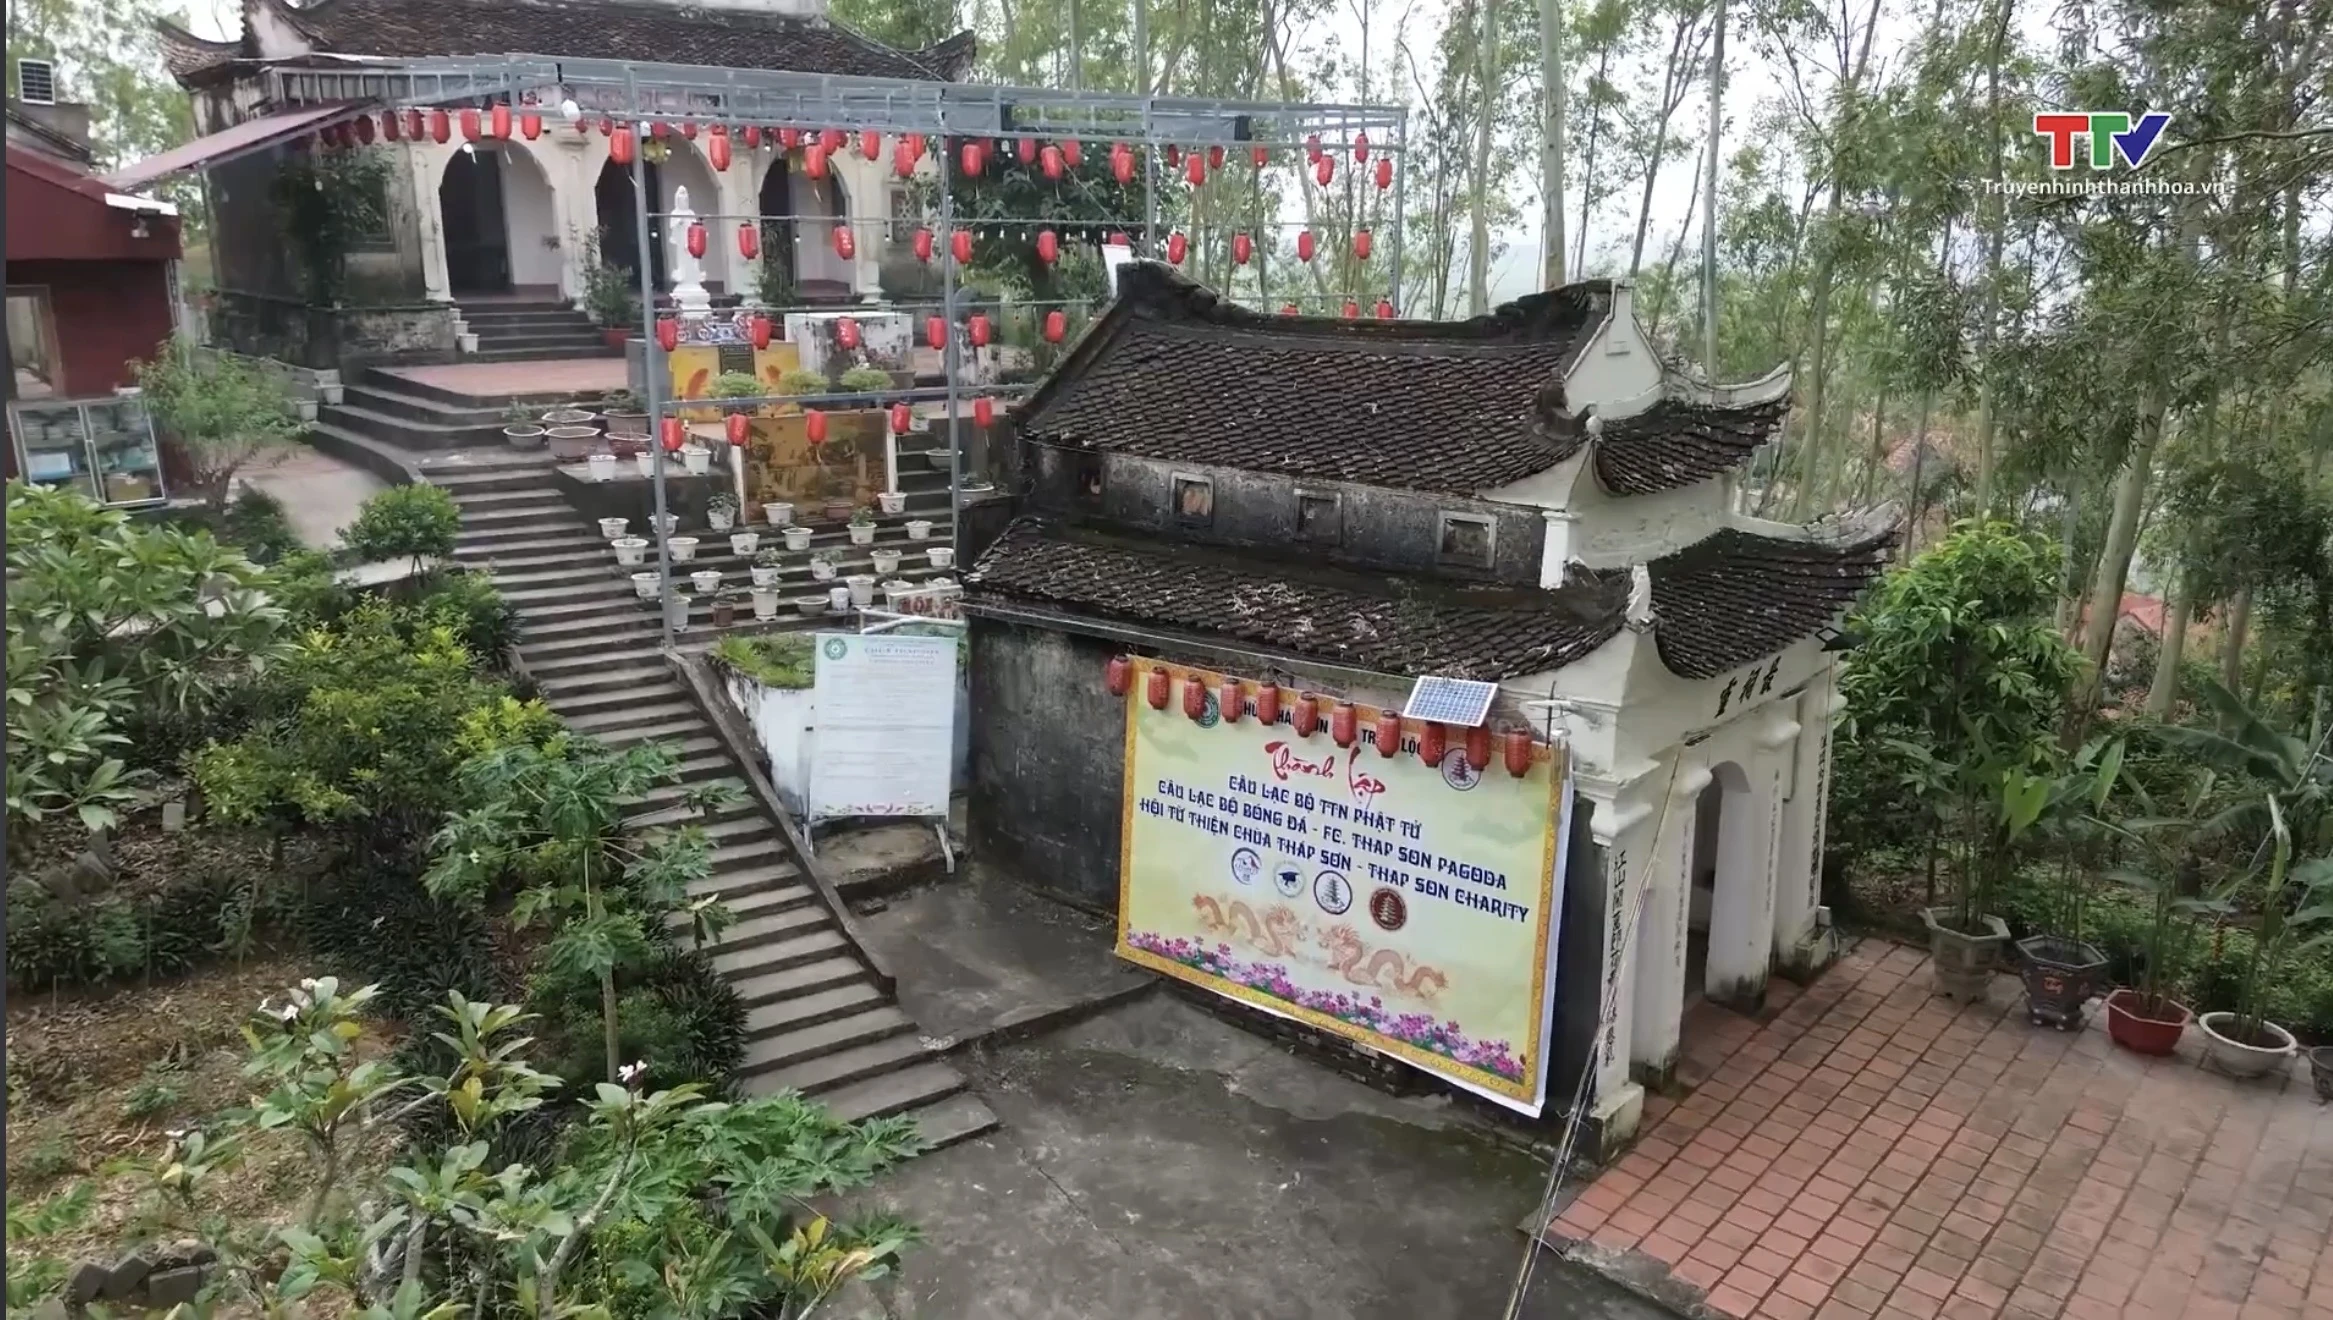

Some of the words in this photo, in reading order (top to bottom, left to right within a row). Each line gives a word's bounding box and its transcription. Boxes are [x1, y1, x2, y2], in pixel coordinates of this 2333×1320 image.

[1265, 741, 1334, 780] Thành
[1158, 779, 1184, 800] CÂU
[1189, 788, 1214, 808] LẠC
[1219, 797, 1238, 816] BỘ
[1243, 802, 1283, 827] BÓNG
[1287, 813, 1308, 834] ĐÁ
[1323, 826, 1346, 845] FC.
[1352, 833, 1393, 857] THAP
[1398, 847, 1432, 870] SON
[1438, 858, 1508, 891] PAGODA
[1229, 775, 1256, 796] CÂU
[1262, 782, 1288, 804] LẠC
[1294, 792, 1314, 812] BỘ
[1320, 799, 1349, 820] TTN
[1354, 808, 1395, 835] PHẬT
[1400, 818, 1423, 840] TỬ
[1140, 798, 1164, 817] HỘI
[1168, 803, 1186, 823] TỪ
[1188, 812, 1229, 836] THIỆN
[1234, 824, 1272, 848] CHÙA
[1277, 836, 1316, 860] THÁP
[1320, 850, 1352, 872] SƠN
[1368, 863, 1409, 888] THAP
[1414, 878, 1449, 900] SON
[1454, 888, 1529, 923] CHARITY
